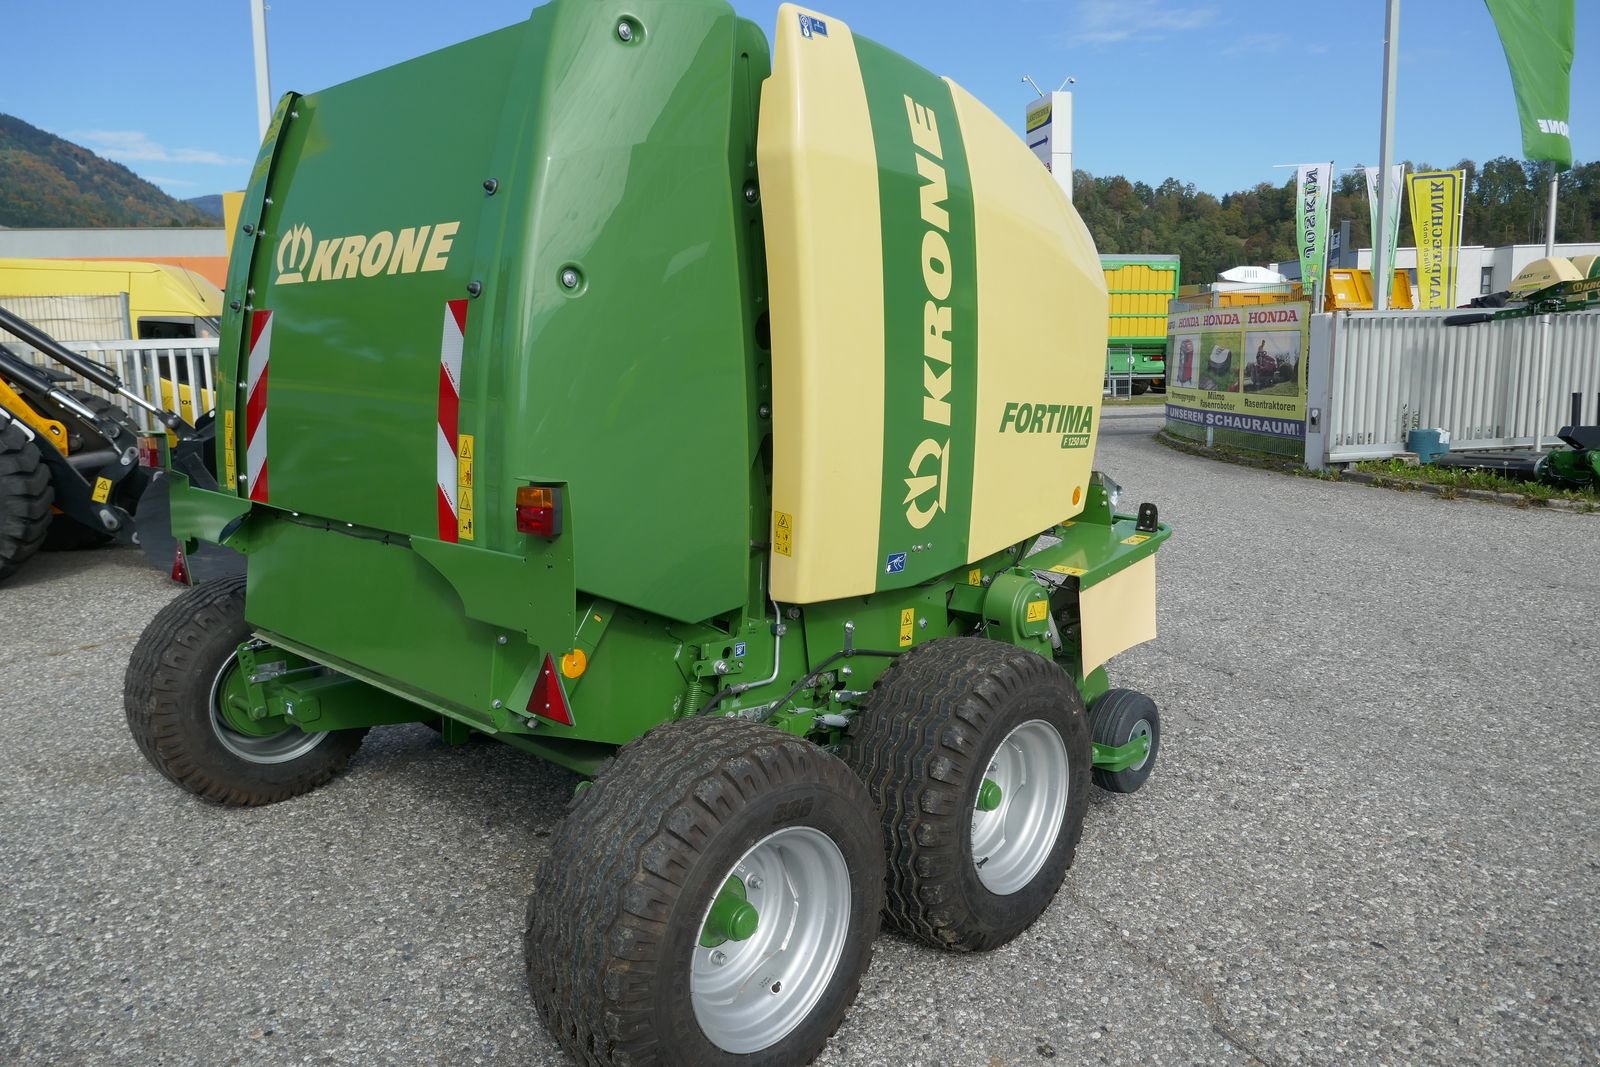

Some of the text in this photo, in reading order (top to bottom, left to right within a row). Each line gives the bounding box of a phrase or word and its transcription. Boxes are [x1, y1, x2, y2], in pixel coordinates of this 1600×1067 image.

[307, 221, 461, 282] KRONE
[903, 93, 952, 427] KRONE
[1203, 313, 1240, 326] HONDA
[1248, 309, 1299, 324] HONDA
[999, 402, 1093, 434] FORTIMA
[1244, 398, 1296, 412] Rasentraktoren
[1169, 407, 1300, 436] UNSEREN SCHAURAUM!
